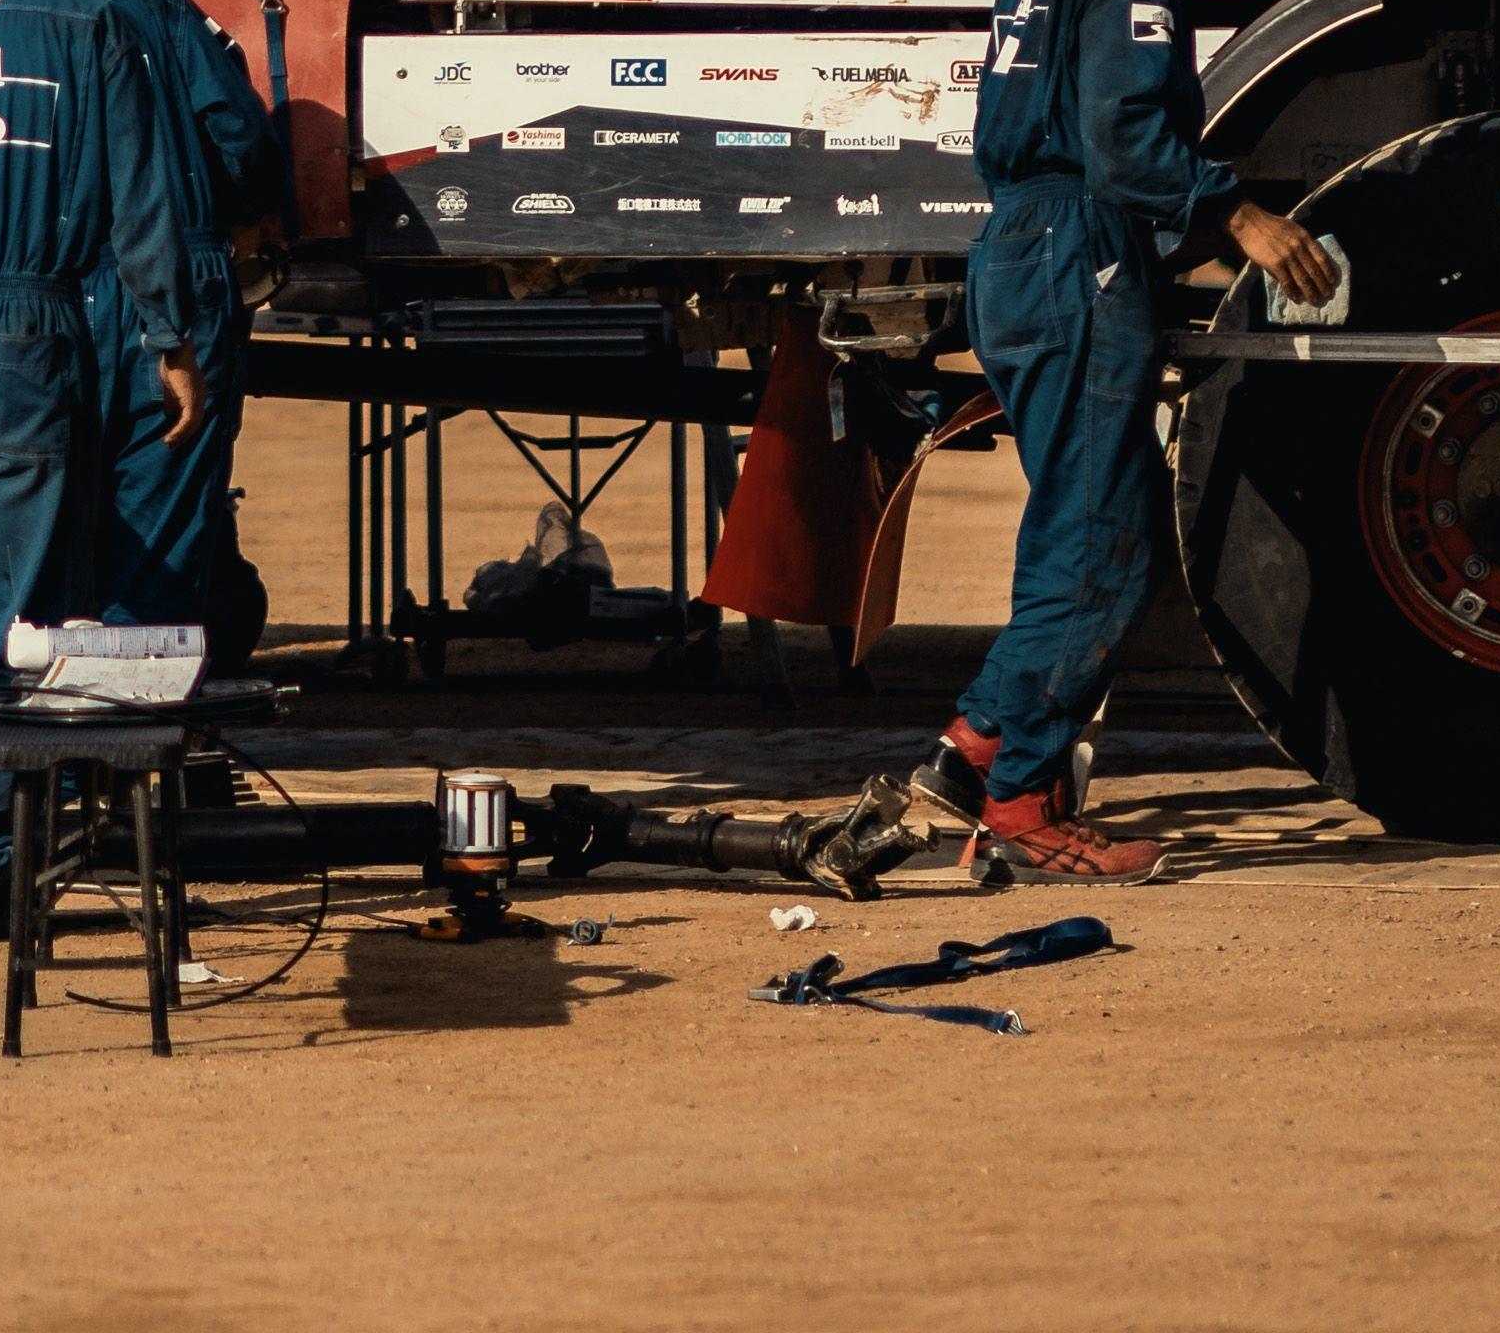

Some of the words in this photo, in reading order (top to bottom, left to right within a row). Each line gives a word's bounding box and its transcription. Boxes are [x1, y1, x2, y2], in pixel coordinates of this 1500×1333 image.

[434, 66, 472, 82] JDC
[515, 62, 571, 76] brother
[614, 61, 665, 83] F.C.C.
[699, 68, 780, 81] SWANS
[831, 67, 910, 83] FUELMEDIA
[521, 129, 562, 140] Yashima
[613, 132, 679, 145] CERAMETA
[717, 132, 788, 146] NORD-LOCK
[519, 199, 569, 209] SHIELD
